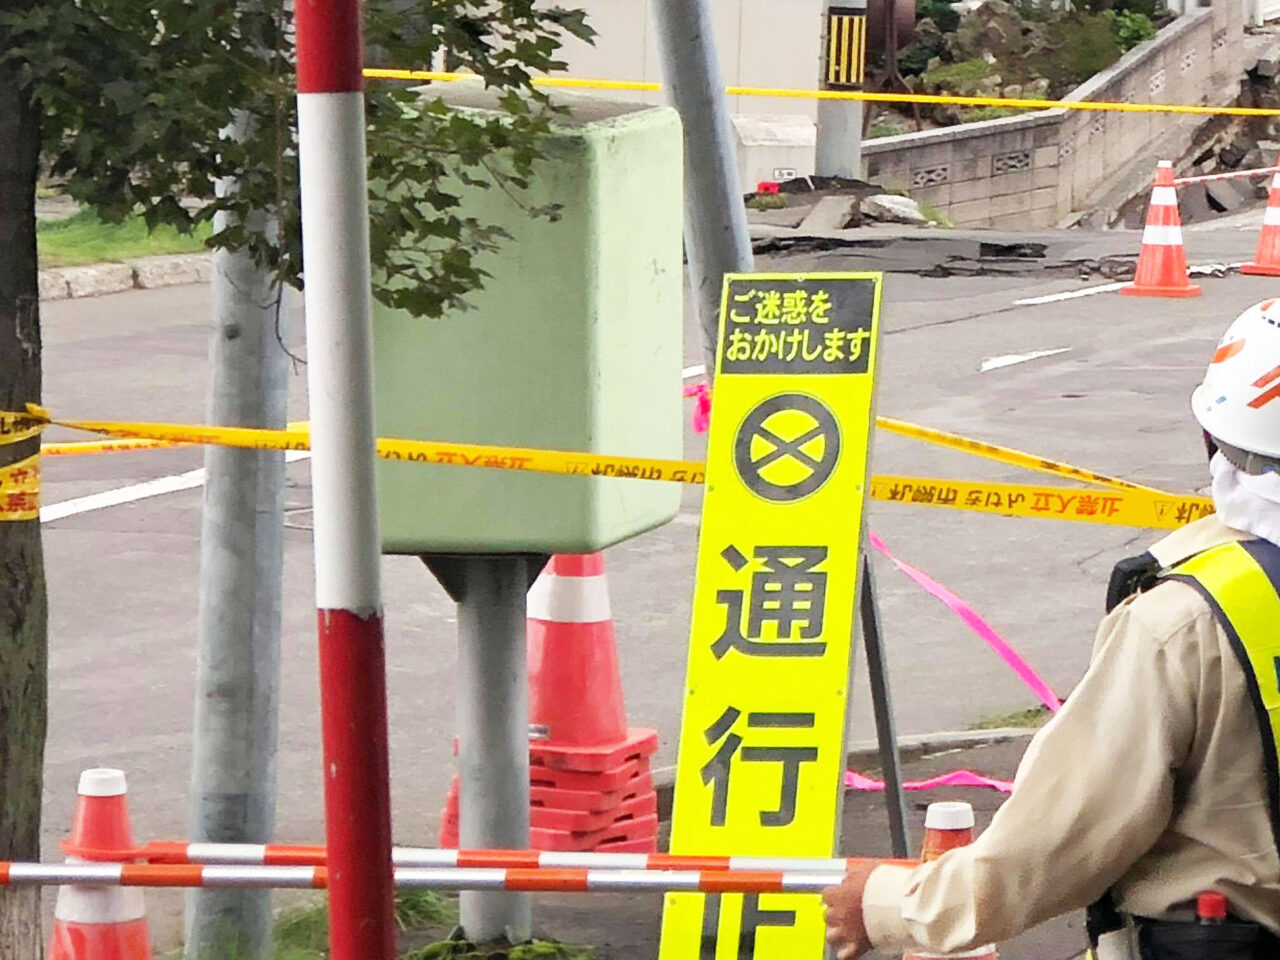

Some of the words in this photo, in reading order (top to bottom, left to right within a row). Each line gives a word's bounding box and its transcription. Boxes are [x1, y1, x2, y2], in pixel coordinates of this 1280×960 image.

[729, 289, 832, 325] ご迷惑を
[726, 327, 870, 362] おかけします
